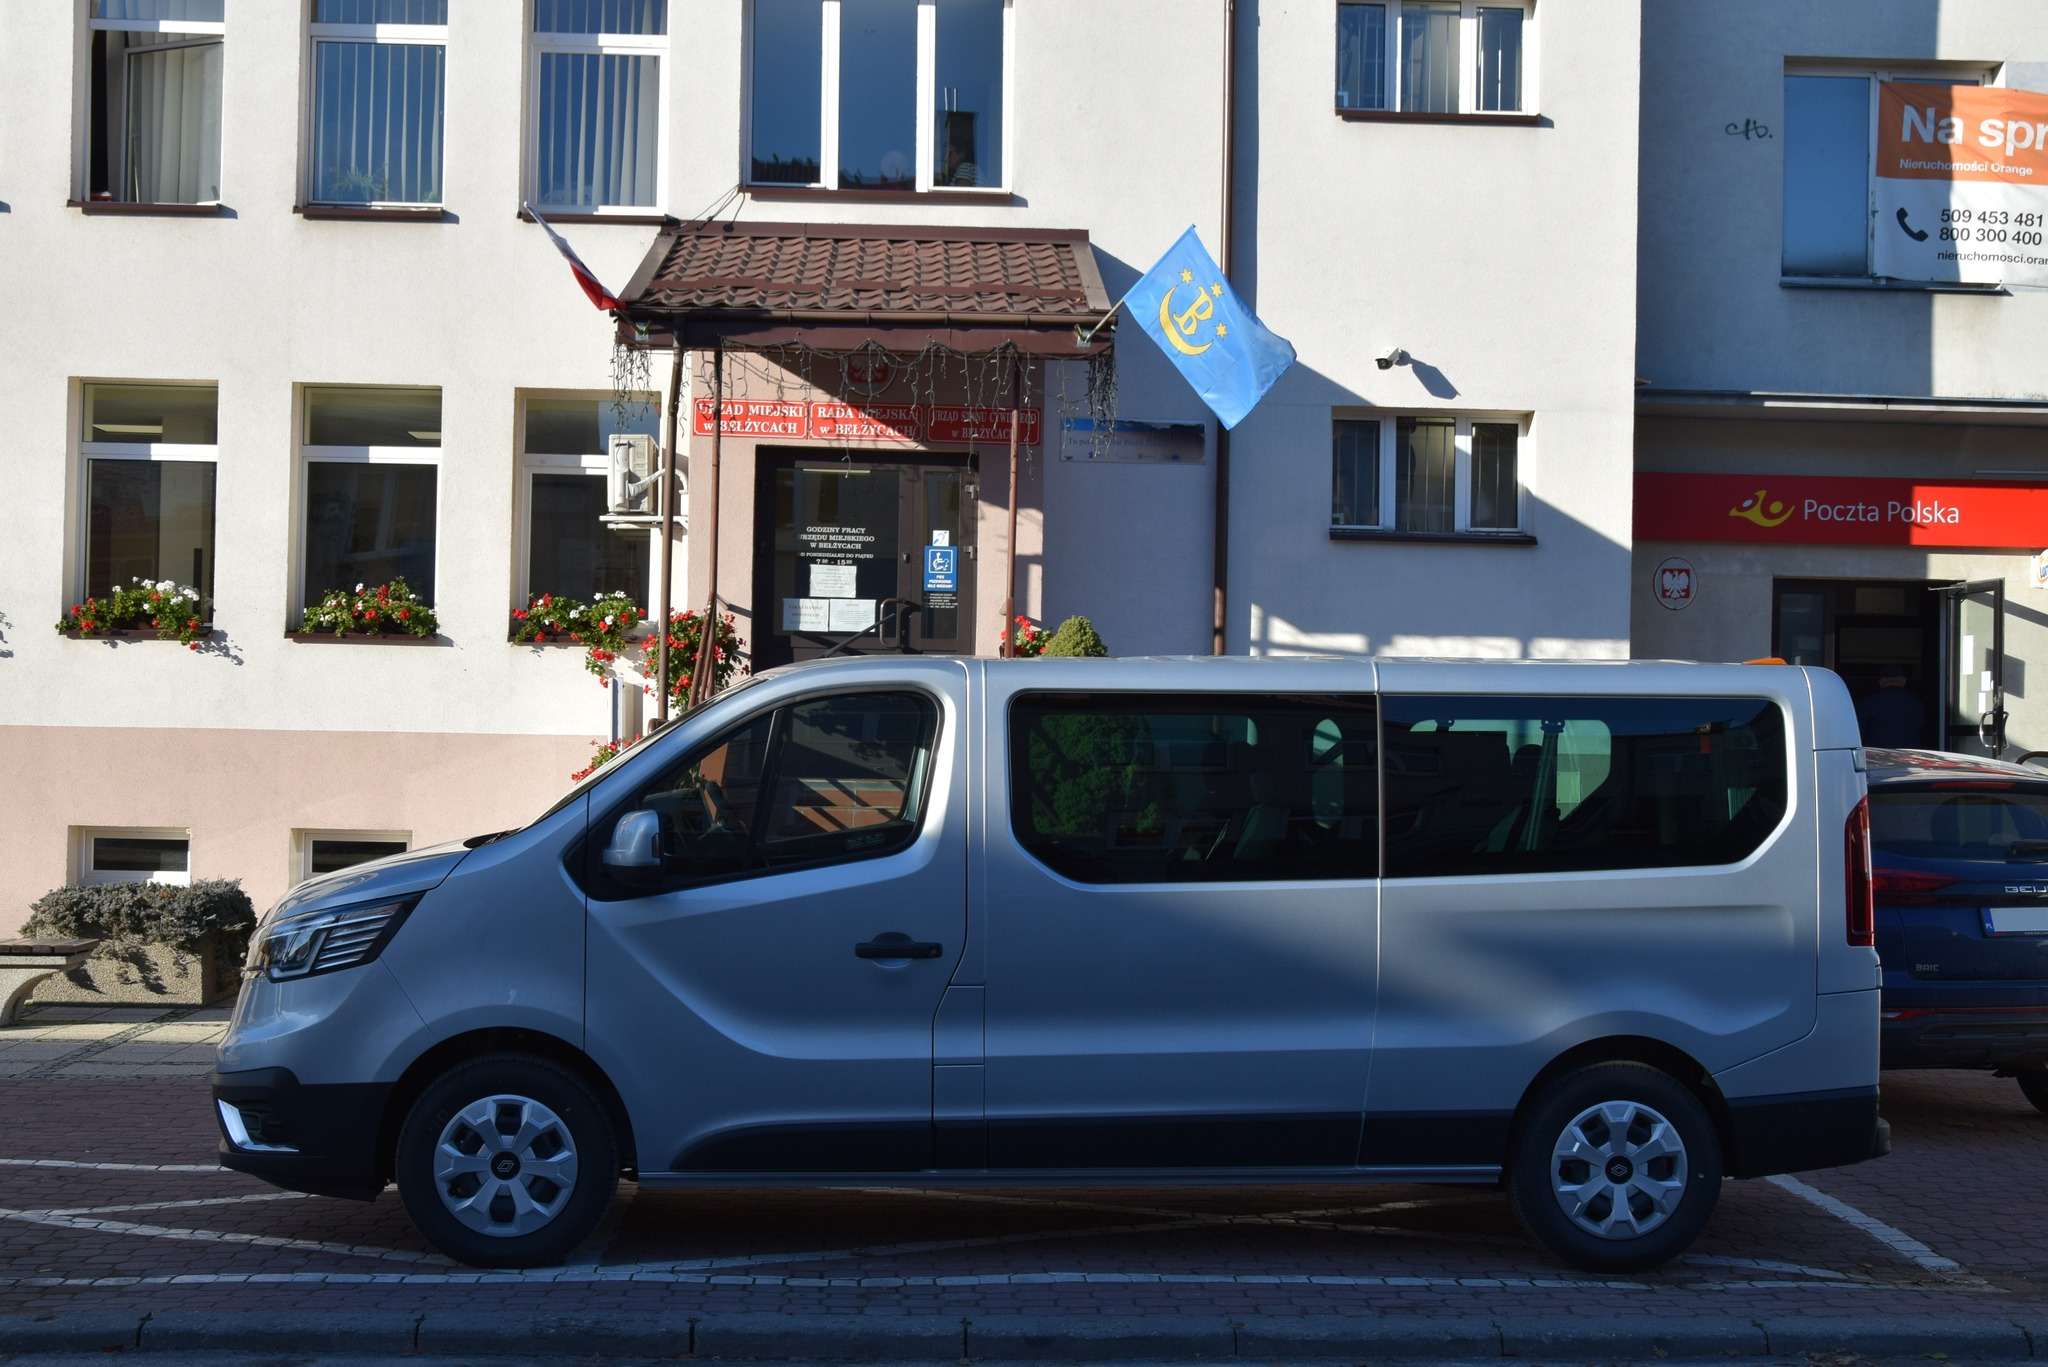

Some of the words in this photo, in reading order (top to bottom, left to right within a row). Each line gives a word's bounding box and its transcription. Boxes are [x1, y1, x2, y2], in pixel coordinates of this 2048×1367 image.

[1901, 104, 1964, 145] Na
[1899, 158, 1988, 173] Nieruchomości
[1990, 162, 2033, 176] Orange
[1940, 208, 1972, 224] 509
[1977, 210, 2009, 226] 453
[2013, 212, 2044, 228] 481
[1939, 227, 1970, 242] 800
[1975, 228, 2007, 243] 300
[2011, 230, 2042, 247] 400
[748, 404, 804, 417] MIEJSKI
[817, 406, 854, 418] RADA
[1804, 498, 1879, 523] Poczta
[1887, 499, 1960, 524] Polska
[2004, 885, 2048, 893] BEIJ
